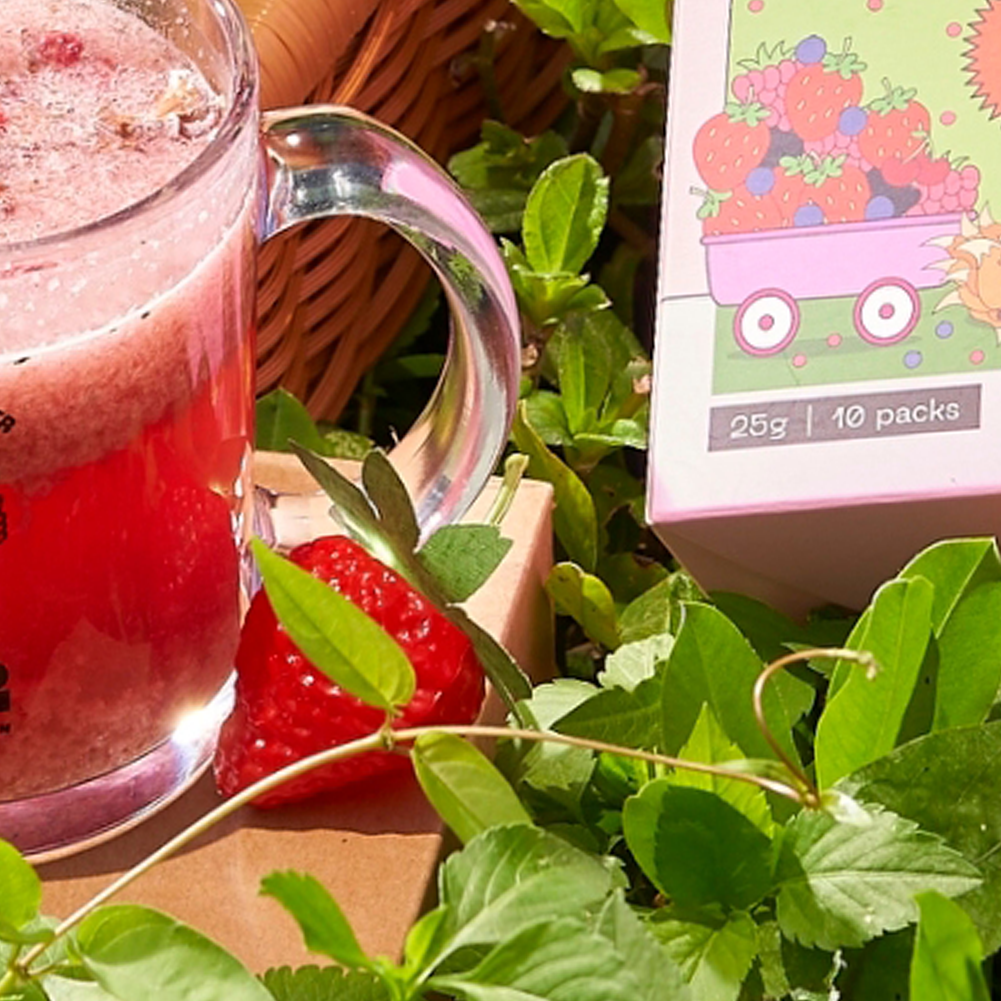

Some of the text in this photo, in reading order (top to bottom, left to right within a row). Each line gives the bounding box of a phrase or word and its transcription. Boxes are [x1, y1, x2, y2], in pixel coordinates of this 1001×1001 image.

[730, 398, 961, 440] 25g 10 packs
